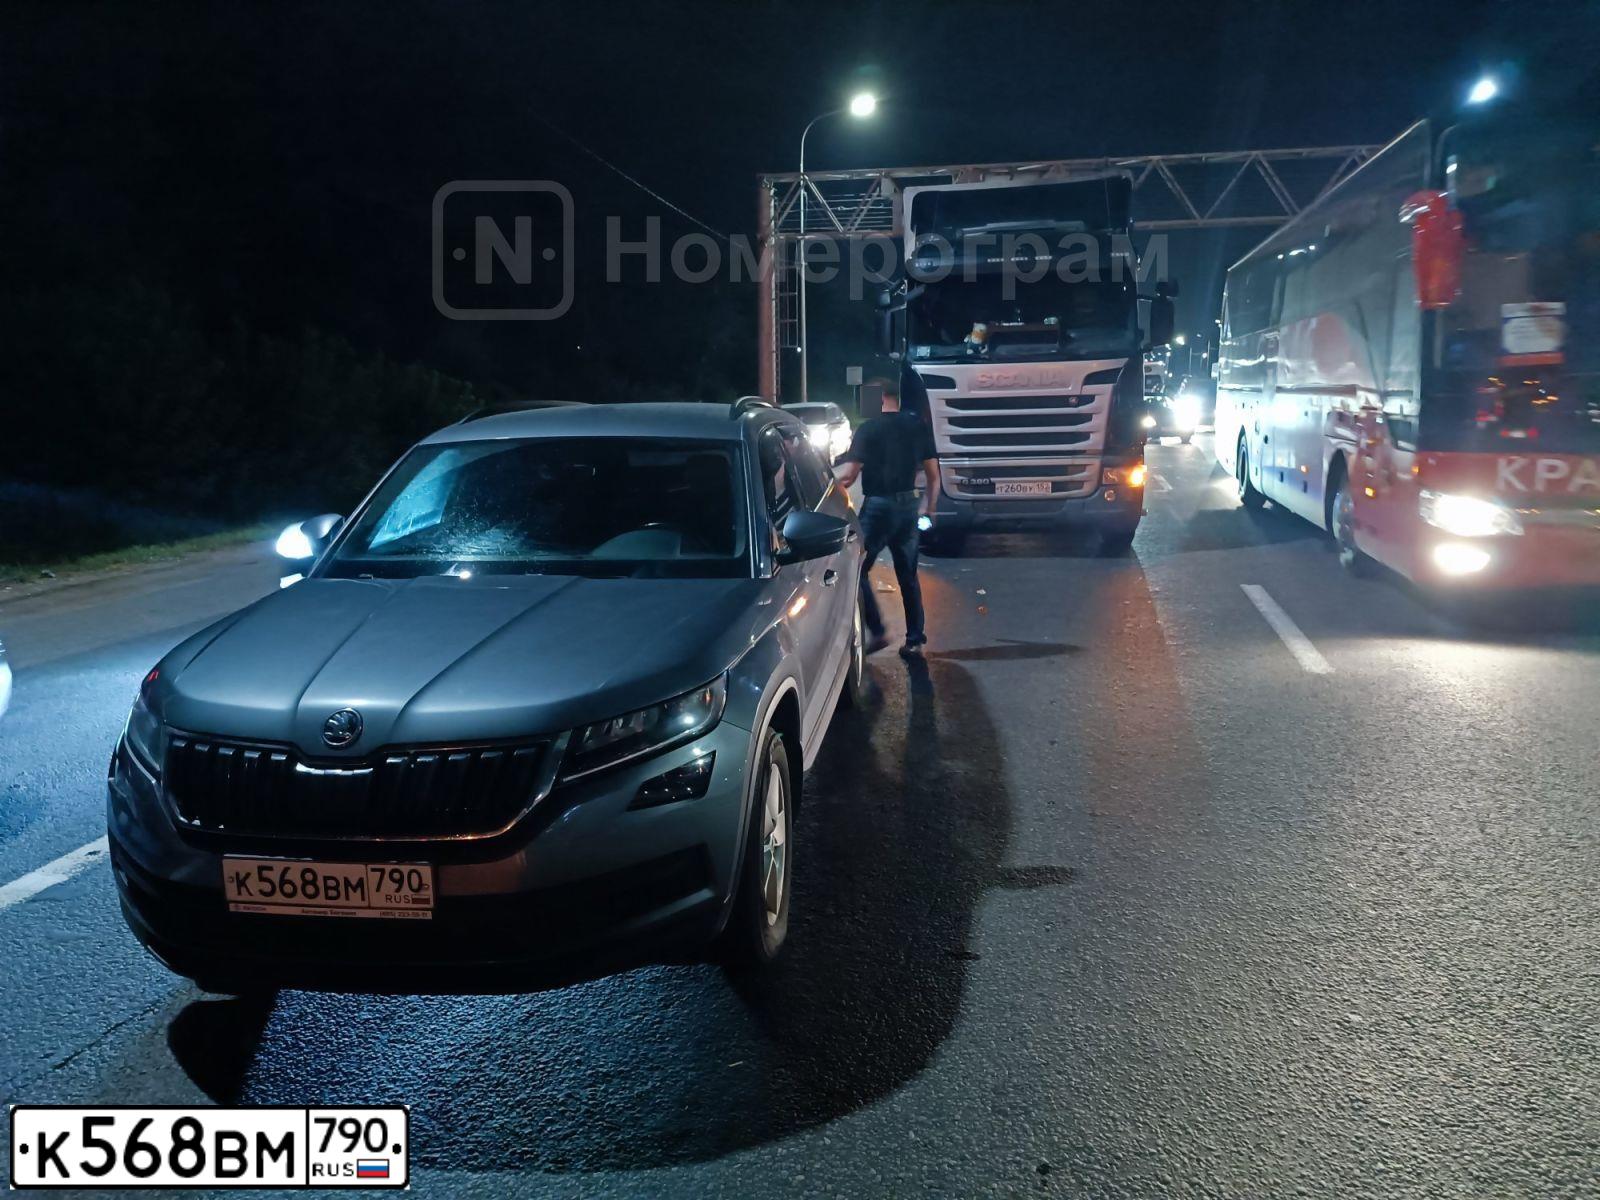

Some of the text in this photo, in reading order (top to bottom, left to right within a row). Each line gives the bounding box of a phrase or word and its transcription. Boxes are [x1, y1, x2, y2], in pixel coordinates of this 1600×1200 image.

[975, 371, 1067, 388] SCANIA
[234, 865, 424, 901] К568ВМ 790
[385, 894, 411, 905] RUS
